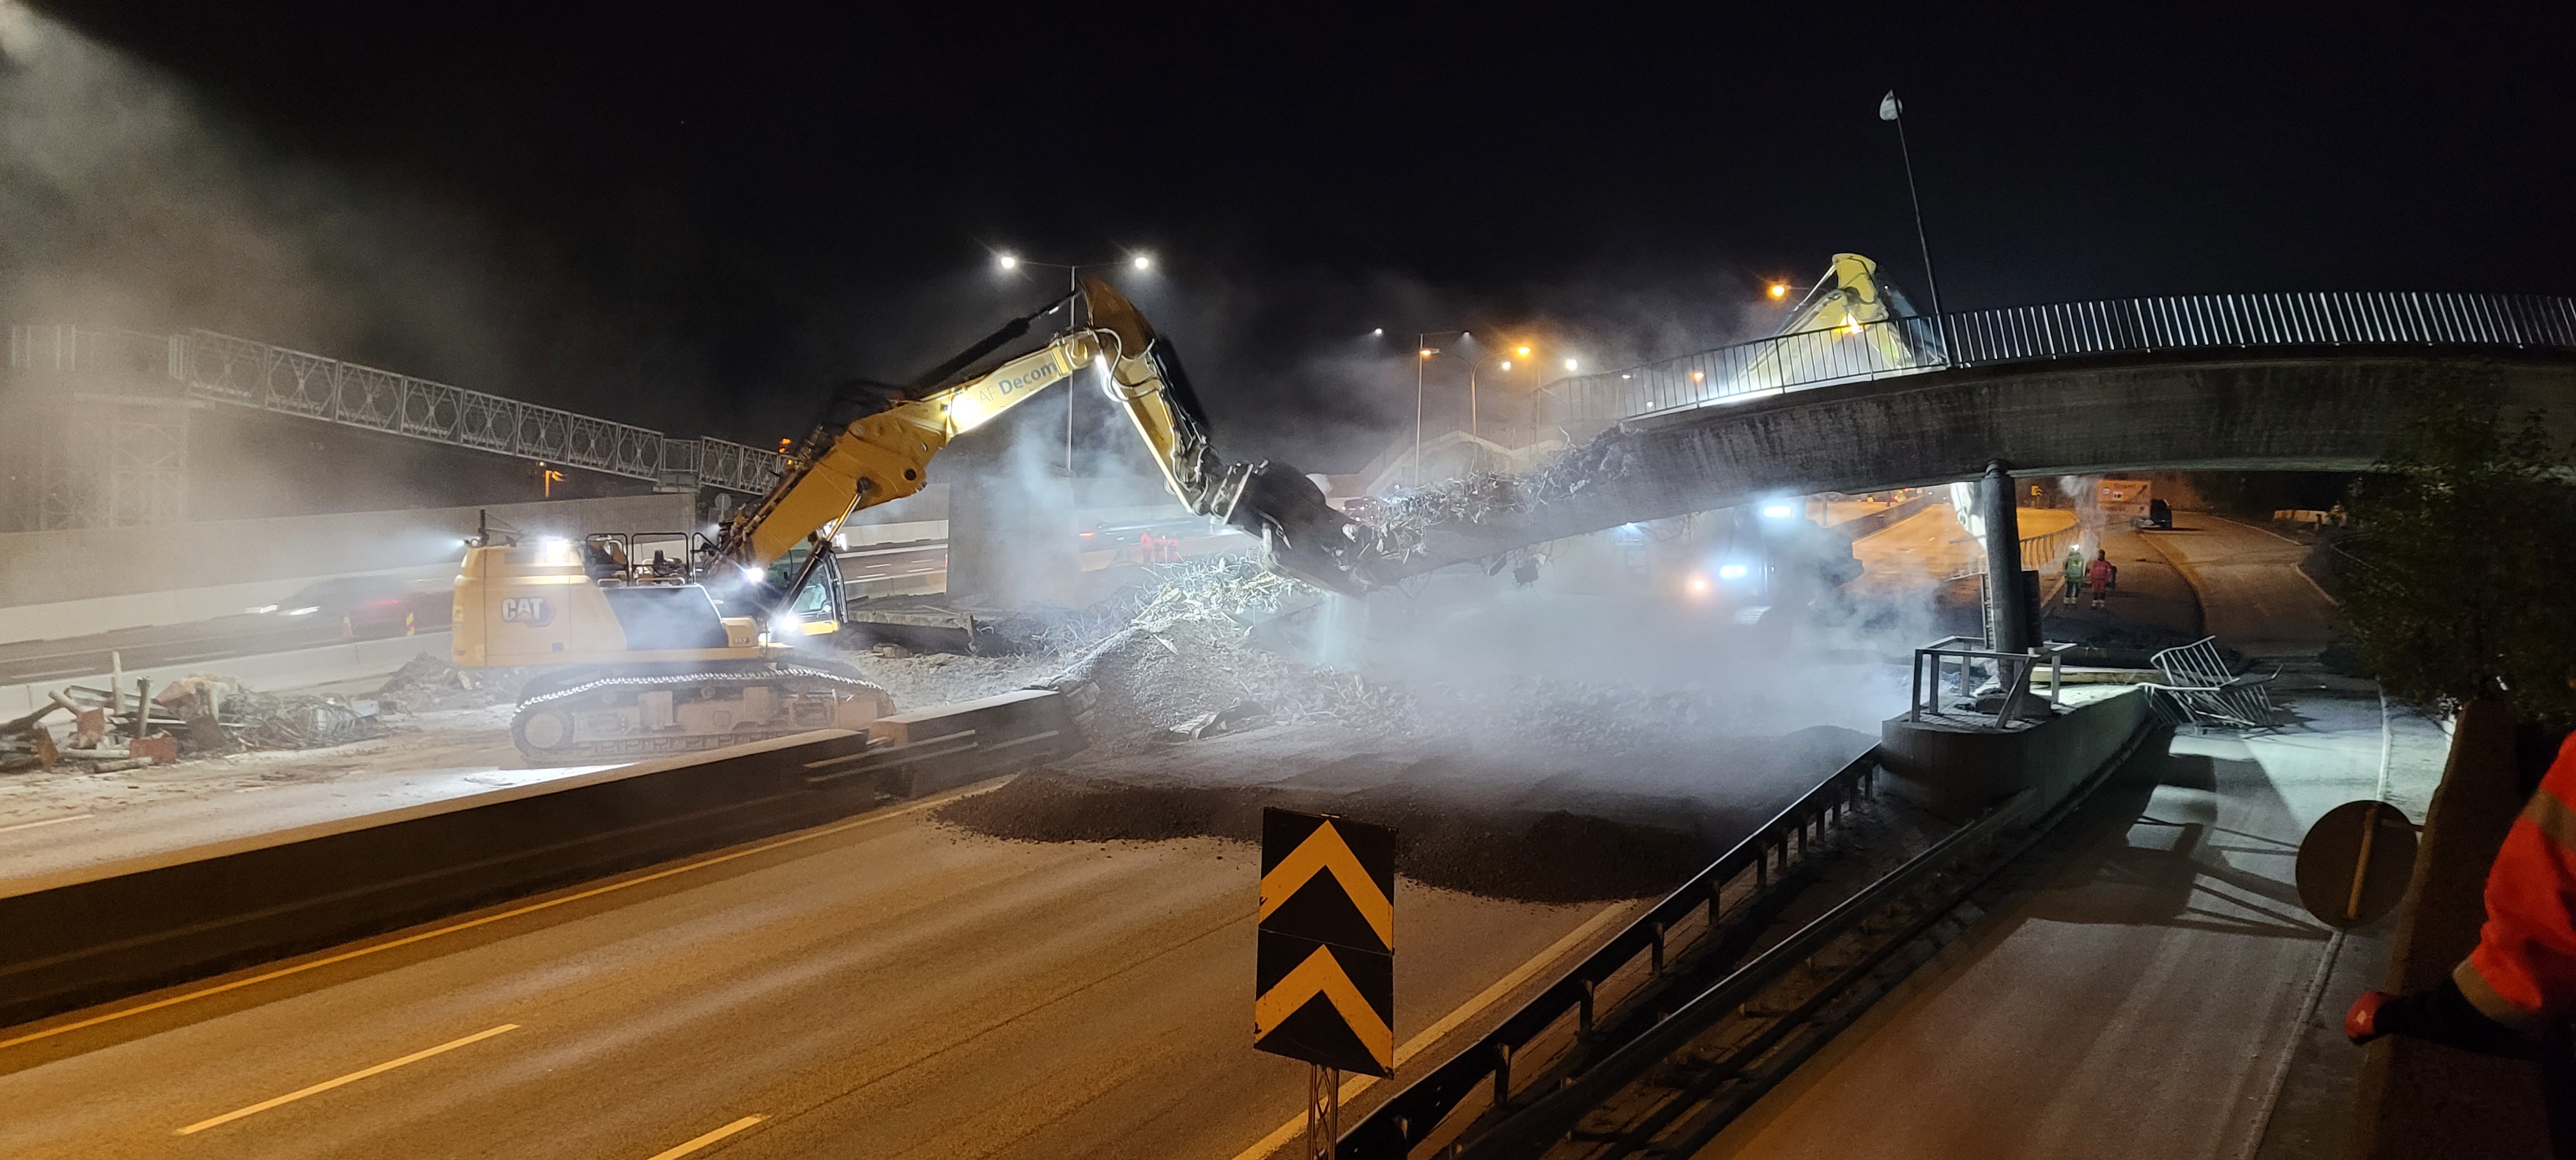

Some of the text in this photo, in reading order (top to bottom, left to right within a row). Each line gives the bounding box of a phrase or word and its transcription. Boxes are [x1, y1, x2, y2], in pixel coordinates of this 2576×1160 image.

[979, 362, 1058, 404] AF Decom
[502, 598, 543, 622] CAT
